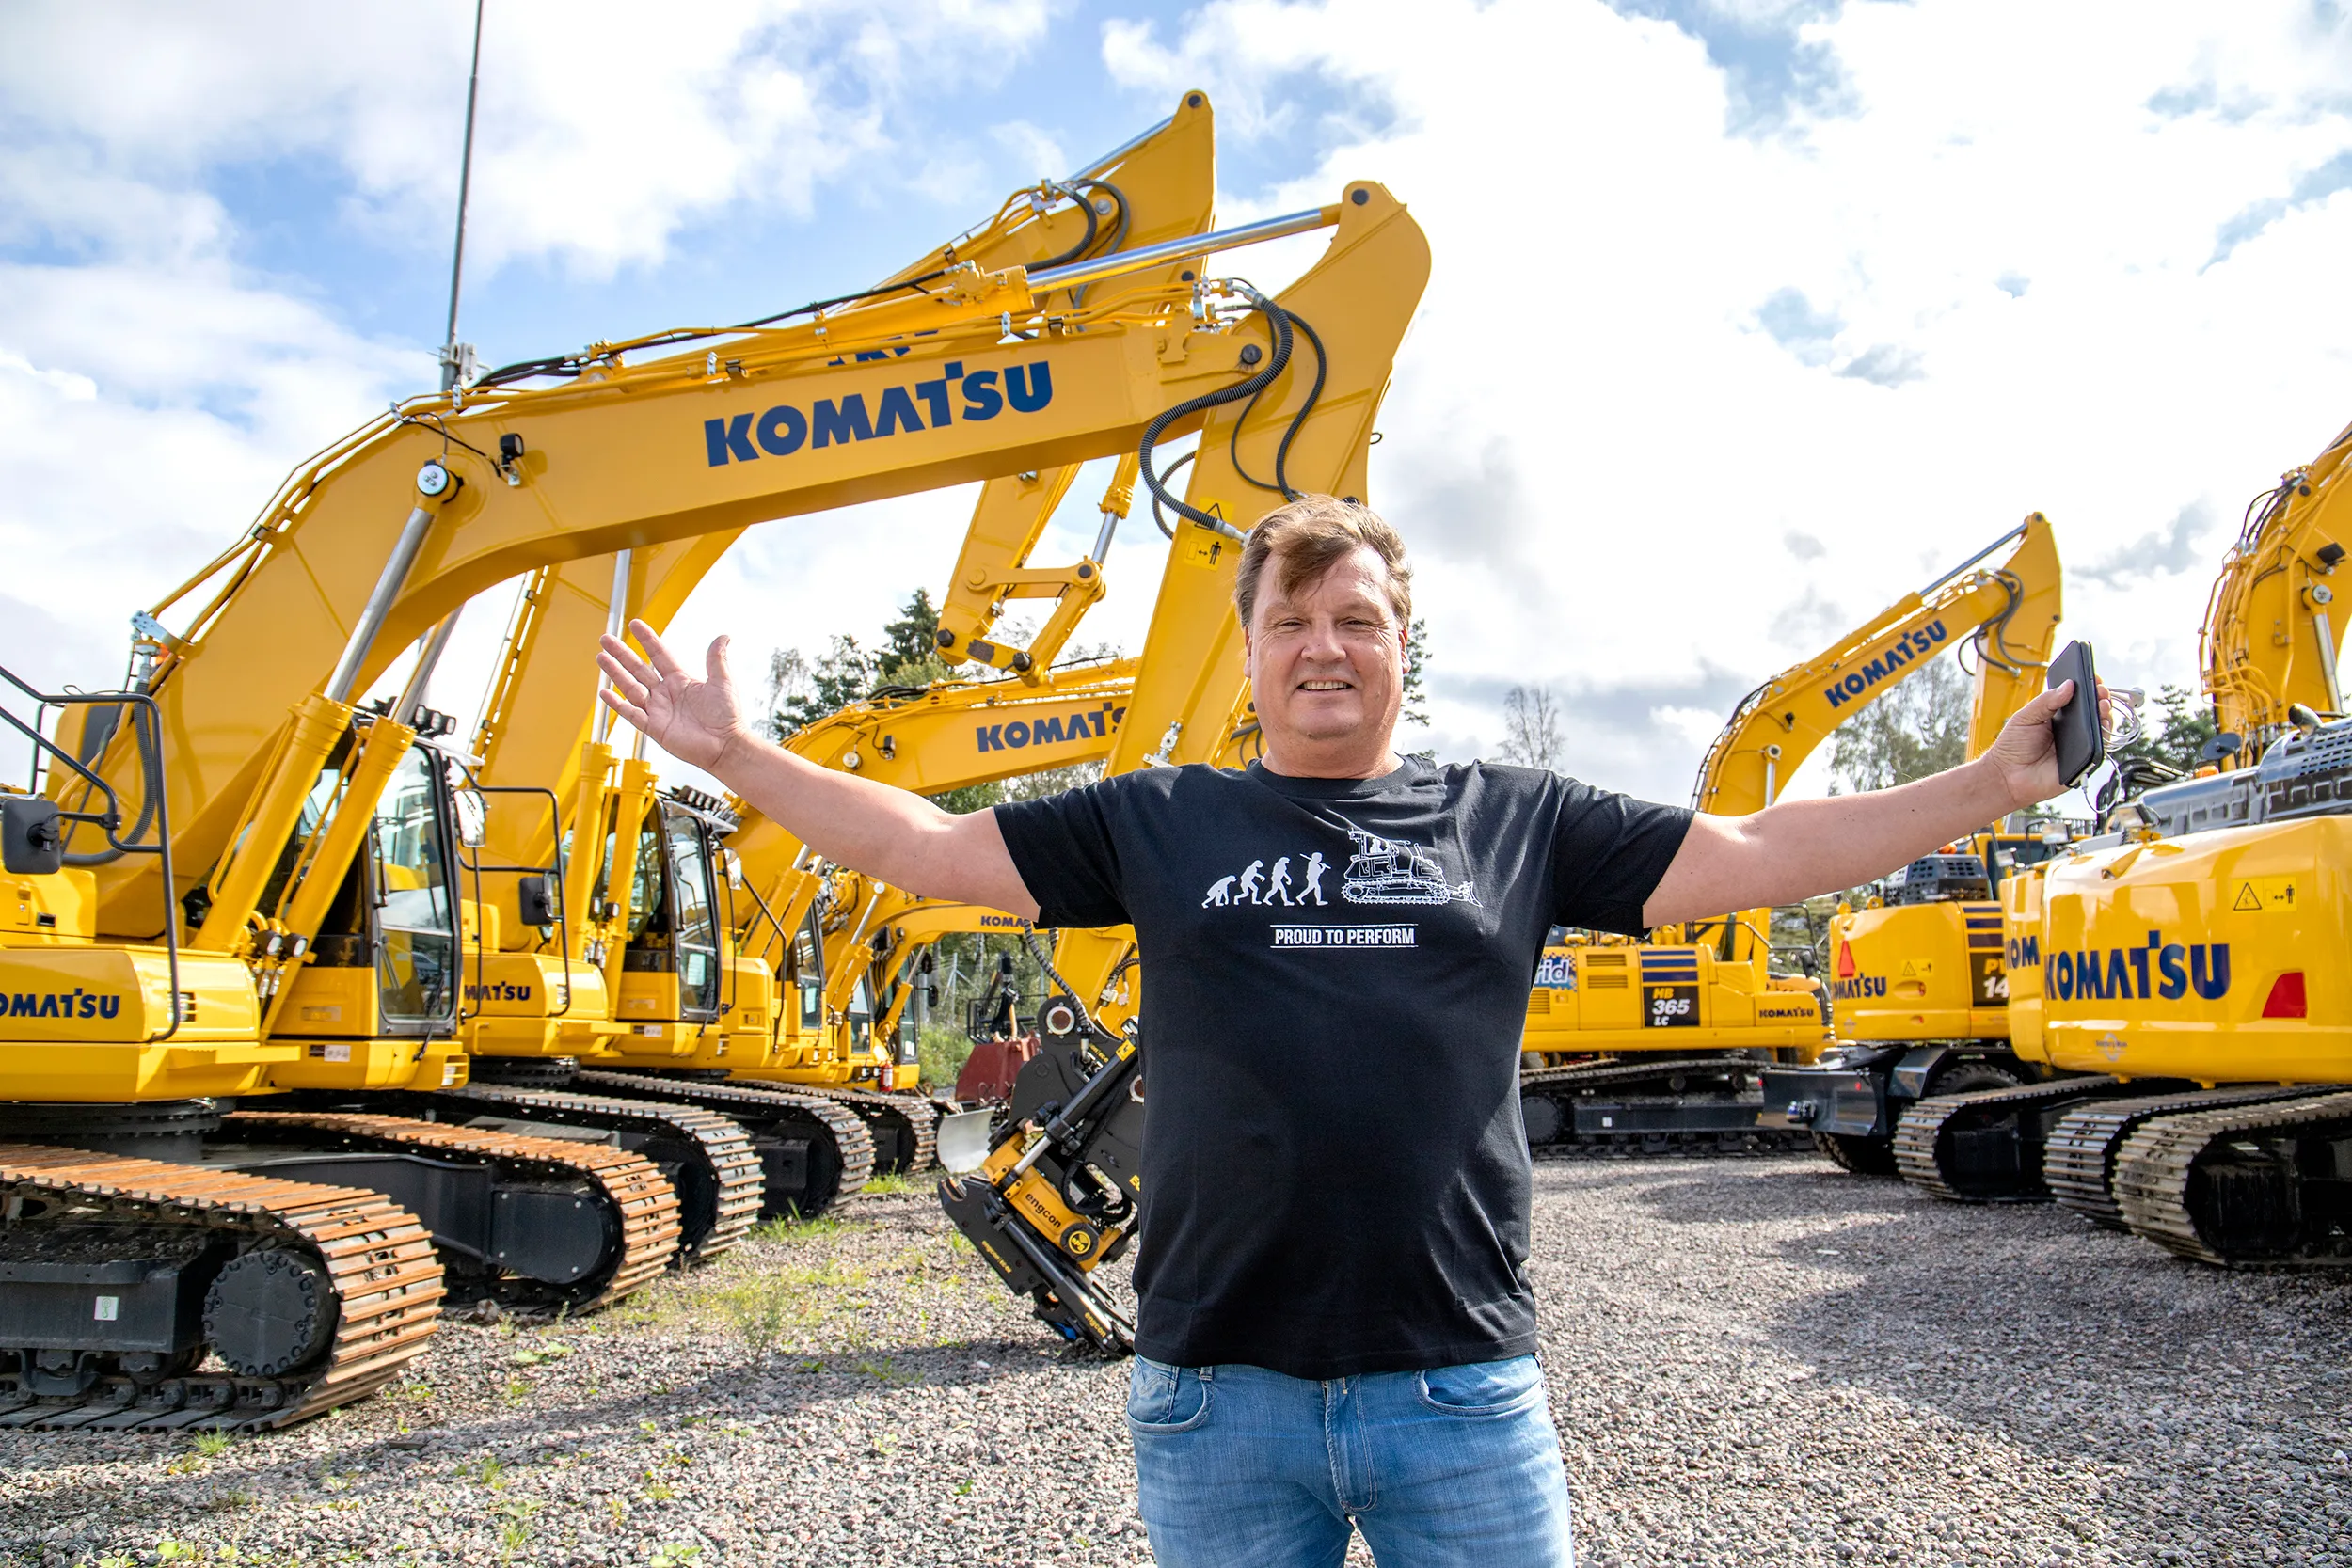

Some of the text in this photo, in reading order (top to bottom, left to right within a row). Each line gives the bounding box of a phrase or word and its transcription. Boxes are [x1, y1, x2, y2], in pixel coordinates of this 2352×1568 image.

[704, 360, 1054, 467] KOMATSU
[1824, 619, 1948, 709] KOMATSU
[980, 915, 1025, 927] KOMA
[1275, 927, 1415, 945] PROUD TO PERFORM
[1534, 959, 1570, 984] rid
[2044, 929, 2232, 1002] KOMATSU
[464, 981, 531, 1001] MATSU
[1653, 988, 1675, 1000] HB
[1983, 976, 2010, 998] 14
[1651, 999, 1691, 1015] 365
[1759, 1006, 1814, 1018] KOMATSU
[1654, 1016, 1670, 1026] LC
[1025, 1192, 1062, 1229] engcon
[1085, 1312, 1106, 1338] engcon
